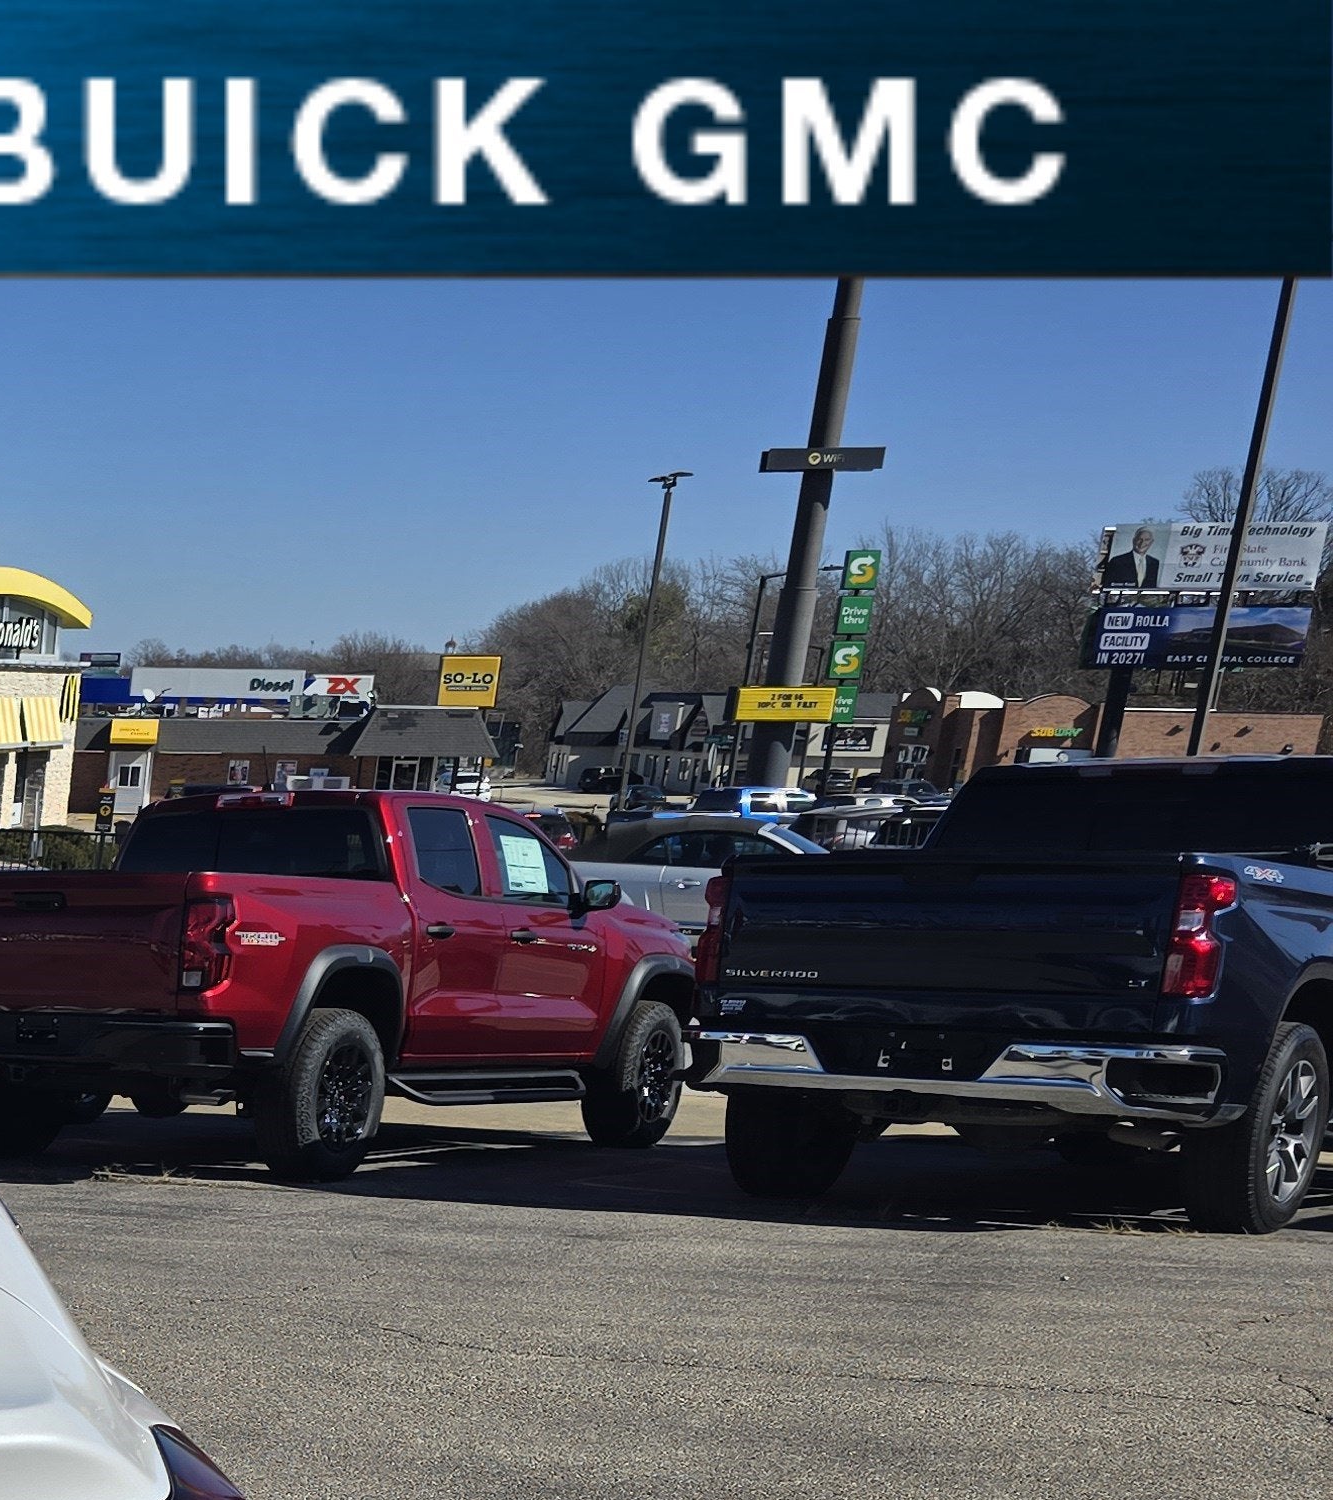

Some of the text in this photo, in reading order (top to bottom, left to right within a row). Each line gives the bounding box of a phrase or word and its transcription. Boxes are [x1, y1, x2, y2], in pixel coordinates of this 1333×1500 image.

[1180, 525, 1202, 538] Big
[1246, 525, 1316, 537] echnology
[1278, 557, 1308, 567] Bank
[1175, 572, 1214, 582] Small
[1254, 571, 1304, 582] Service
[842, 606, 869, 616] Drive
[843, 616, 865, 625] thru
[1107, 615, 1170, 627] NEW ROLLA
[1103, 635, 1147, 647] FACILITY
[1096, 652, 1109, 664] IN
[1166, 655, 1193, 663] EAST
[1247, 656, 1295, 664] COLLEGE
[443, 672, 493, 684] SO-LO
[249, 678, 294, 692] Diesel
[326, 677, 361, 695] ZX
[834, 696, 853, 705] rive
[834, 706, 849, 714] hru
[1031, 727, 1083, 737] SUBWAY
[725, 968, 819, 978] SILVERADO
